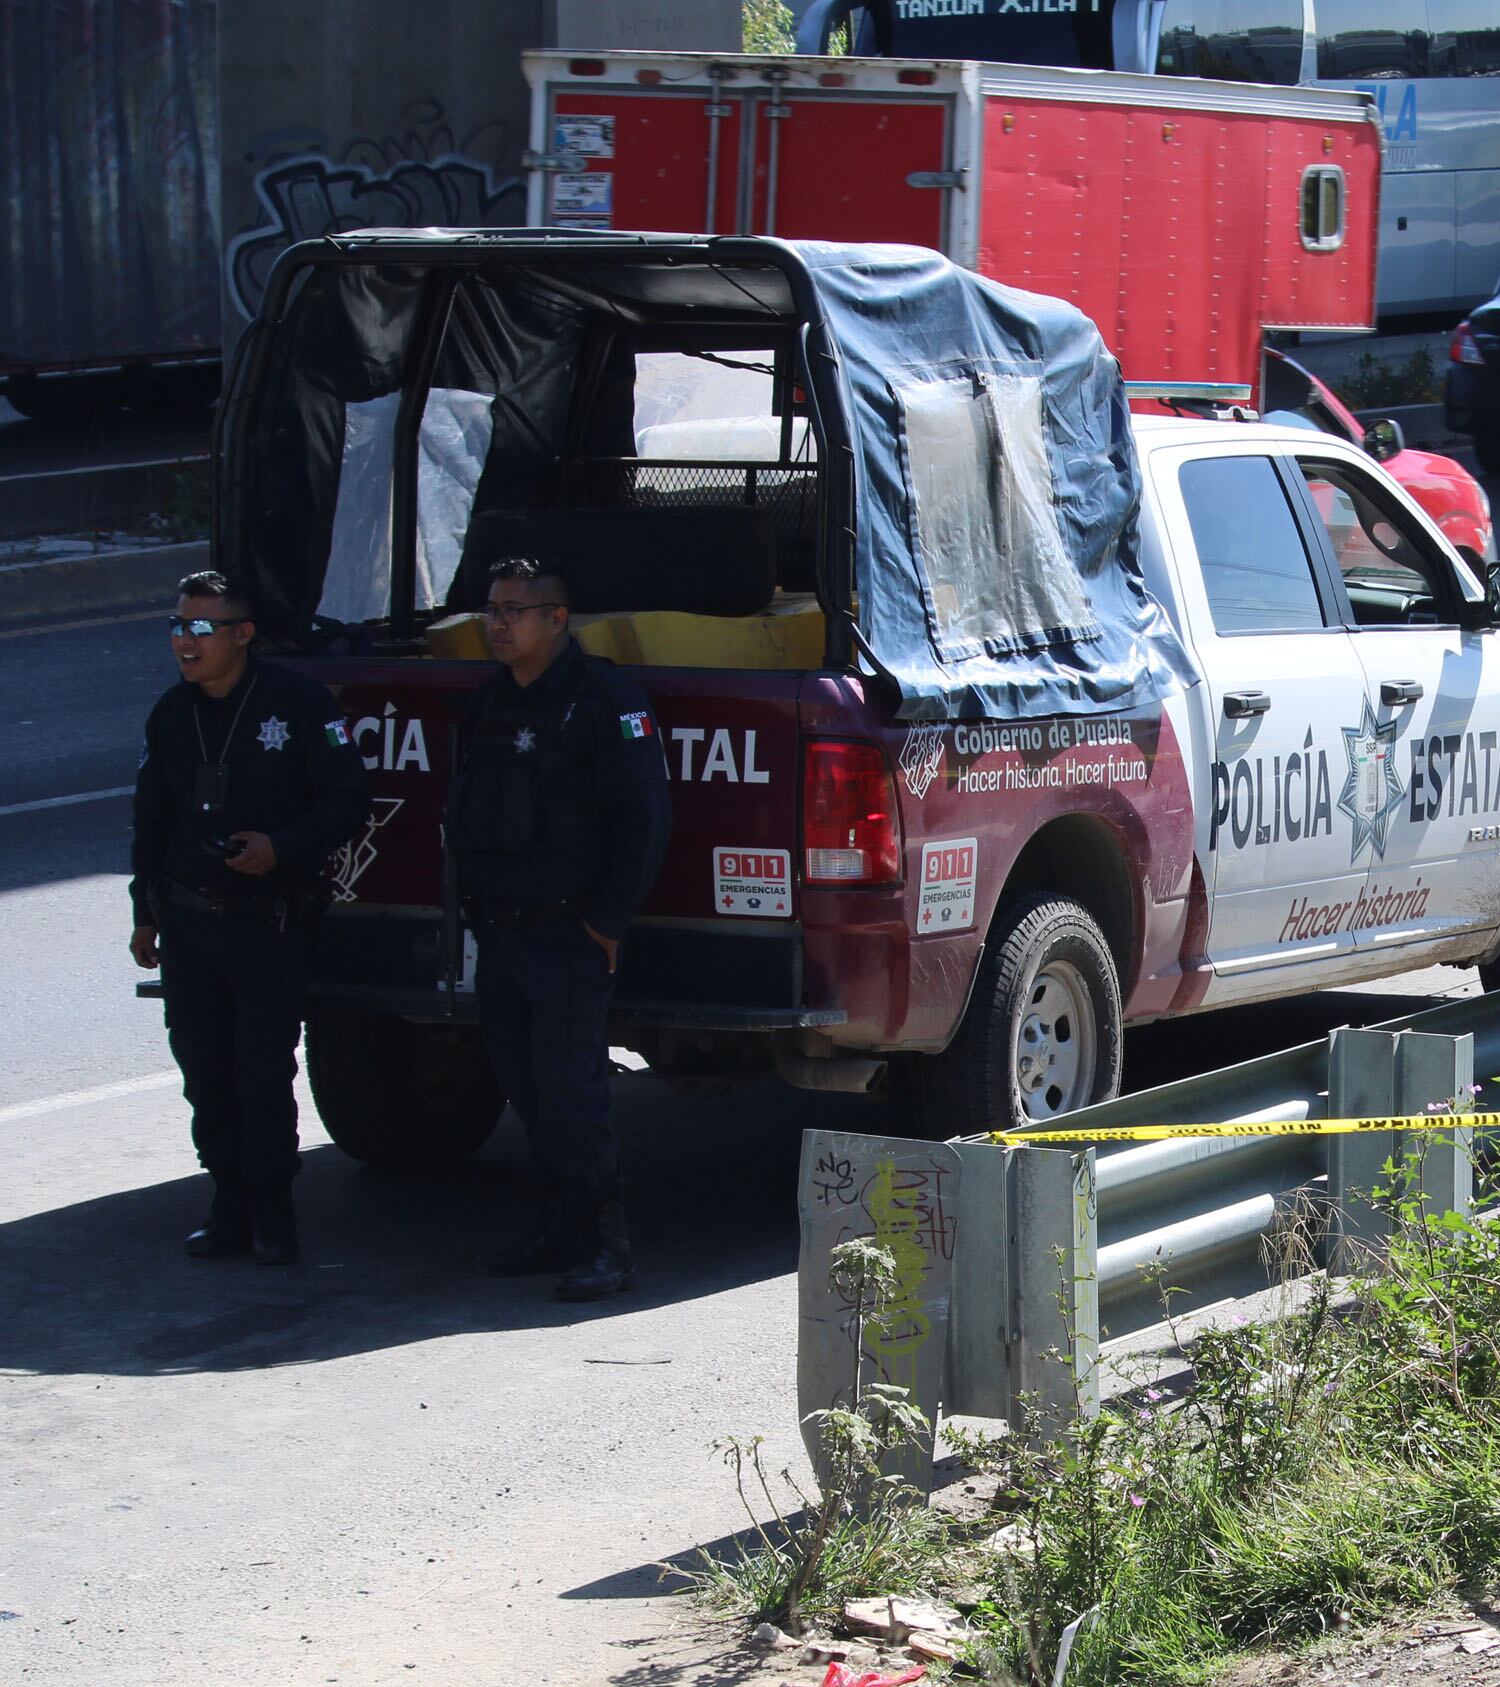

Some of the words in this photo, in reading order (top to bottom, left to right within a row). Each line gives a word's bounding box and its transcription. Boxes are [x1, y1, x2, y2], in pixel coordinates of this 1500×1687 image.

[954, 719, 1042, 755] Gobierno
[1049, 718, 1069, 750] de
[1076, 713, 1131, 747] Puebla
[657, 727, 770, 784] TAL
[958, 765, 1002, 794] Hacer
[1006, 761, 1062, 790] historia.
[1066, 757, 1105, 785] Hacer
[1108, 755, 1147, 790] futuro.
[1209, 723, 1332, 852] POLICÍA
[724, 857, 778, 876] 911
[929, 852, 969, 879] 911
[720, 885, 786, 895] EMERGENCIAS
[923, 889, 971, 904] EMERGENCIAS
[1278, 898, 1352, 943] Hacer
